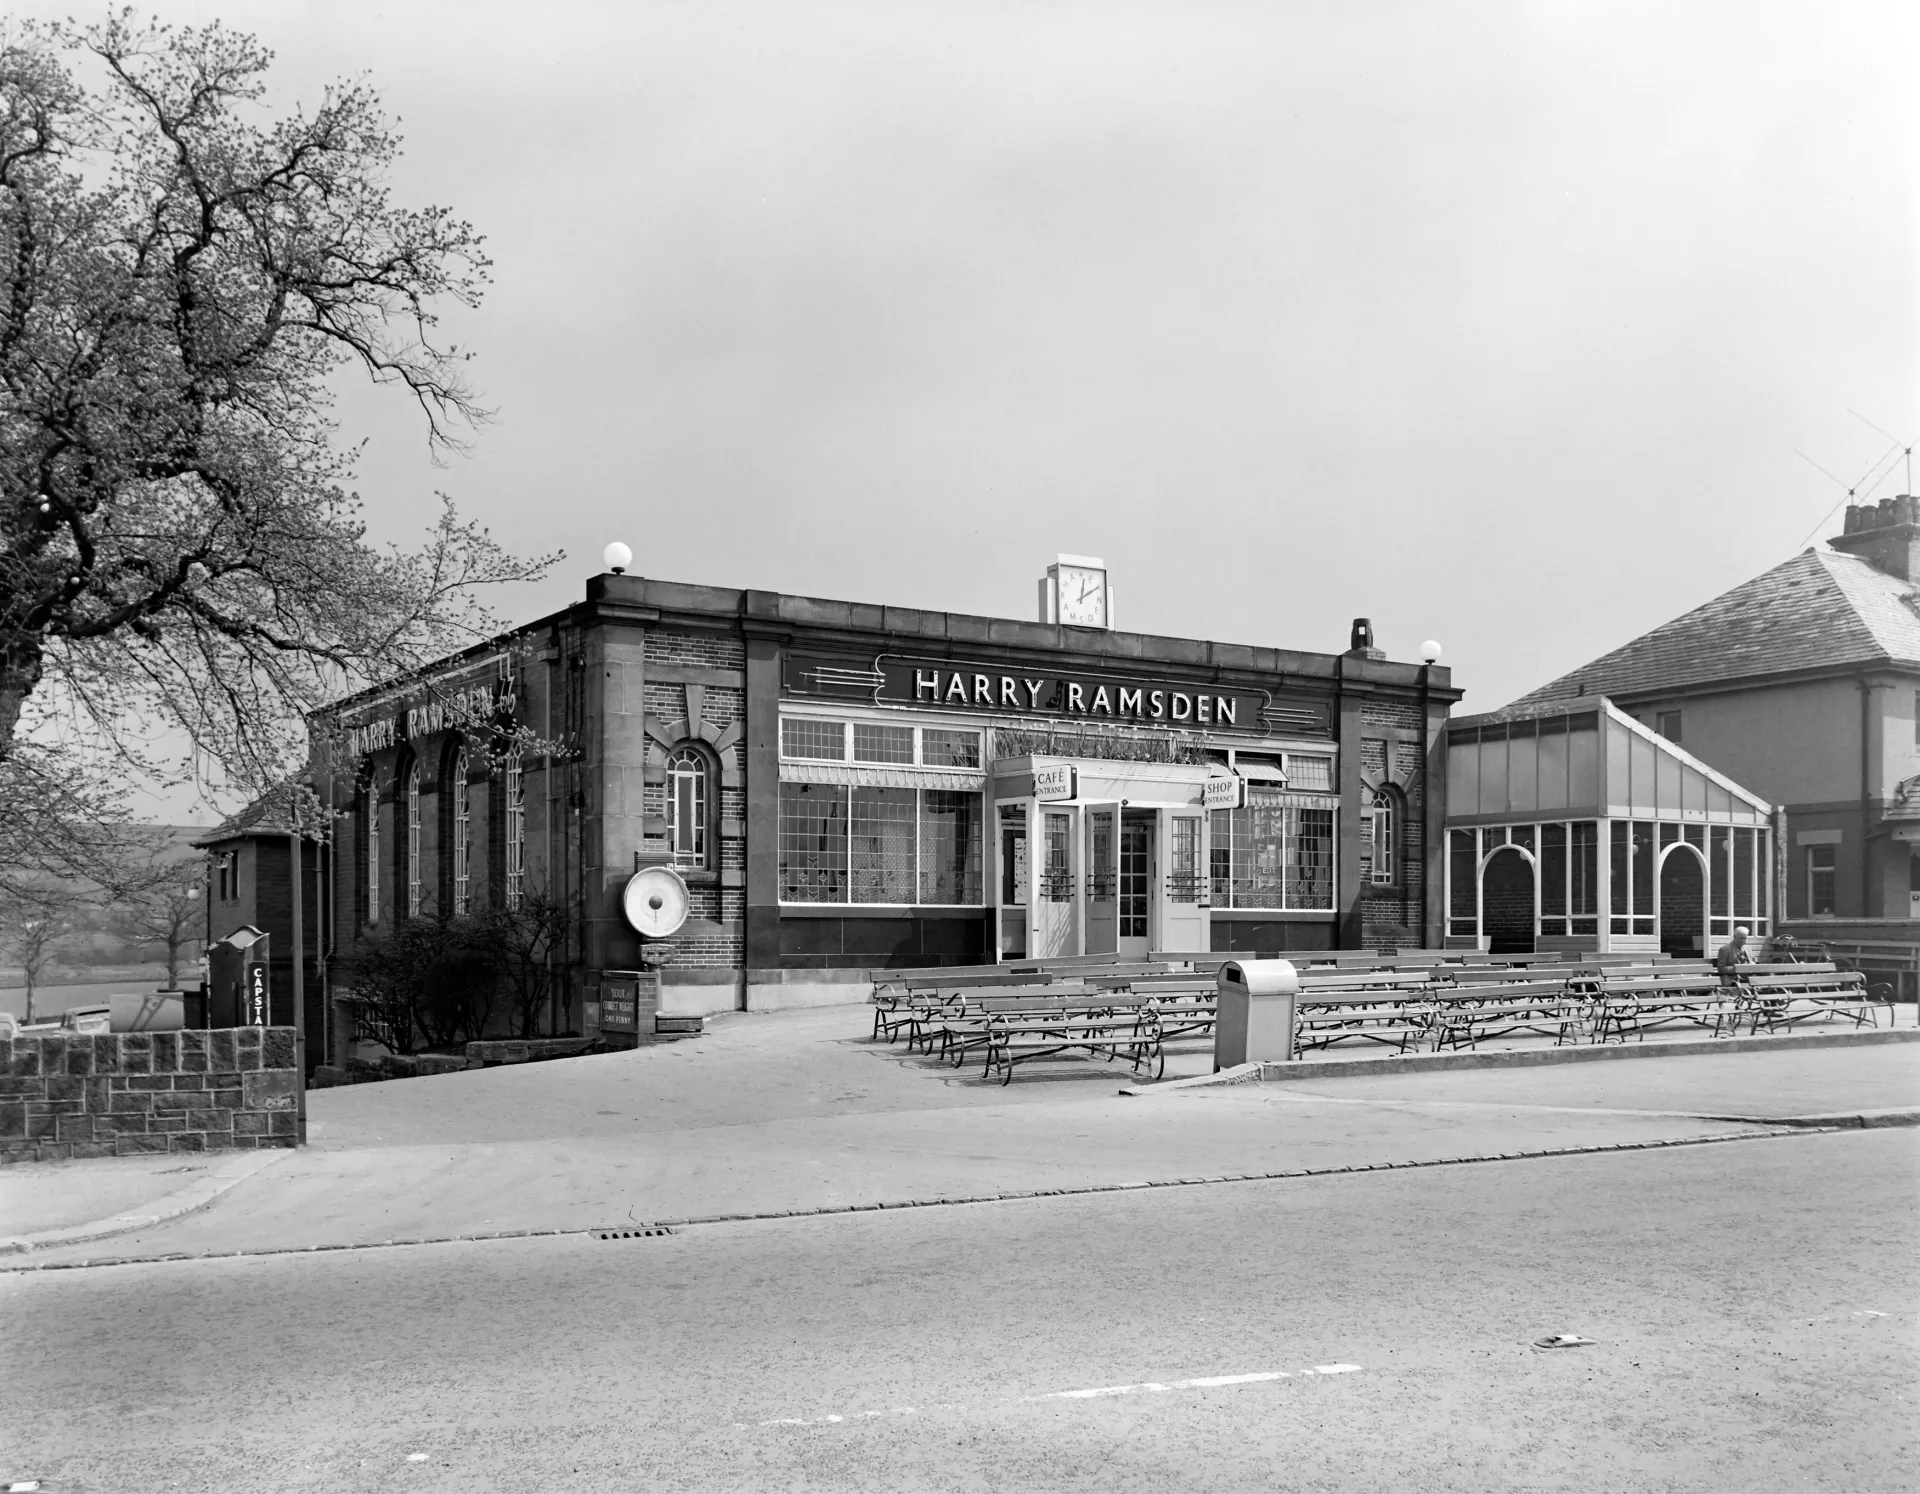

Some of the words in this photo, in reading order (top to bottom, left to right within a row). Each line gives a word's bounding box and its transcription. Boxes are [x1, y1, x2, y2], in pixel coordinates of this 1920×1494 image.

[915, 669, 1044, 708] HARRY
[1067, 682, 1237, 724] RAMSDEN
[350, 716, 397, 758] HARRY
[1038, 768, 1064, 784] CAFÉ
[1035, 786, 1067, 796] ENTRANCE
[1208, 782, 1232, 793] SHOP
[1204, 795, 1234, 804] ENTRANCE
[605, 1014, 615, 1023] ONE
[616, 1016, 631, 1024] PENNY
